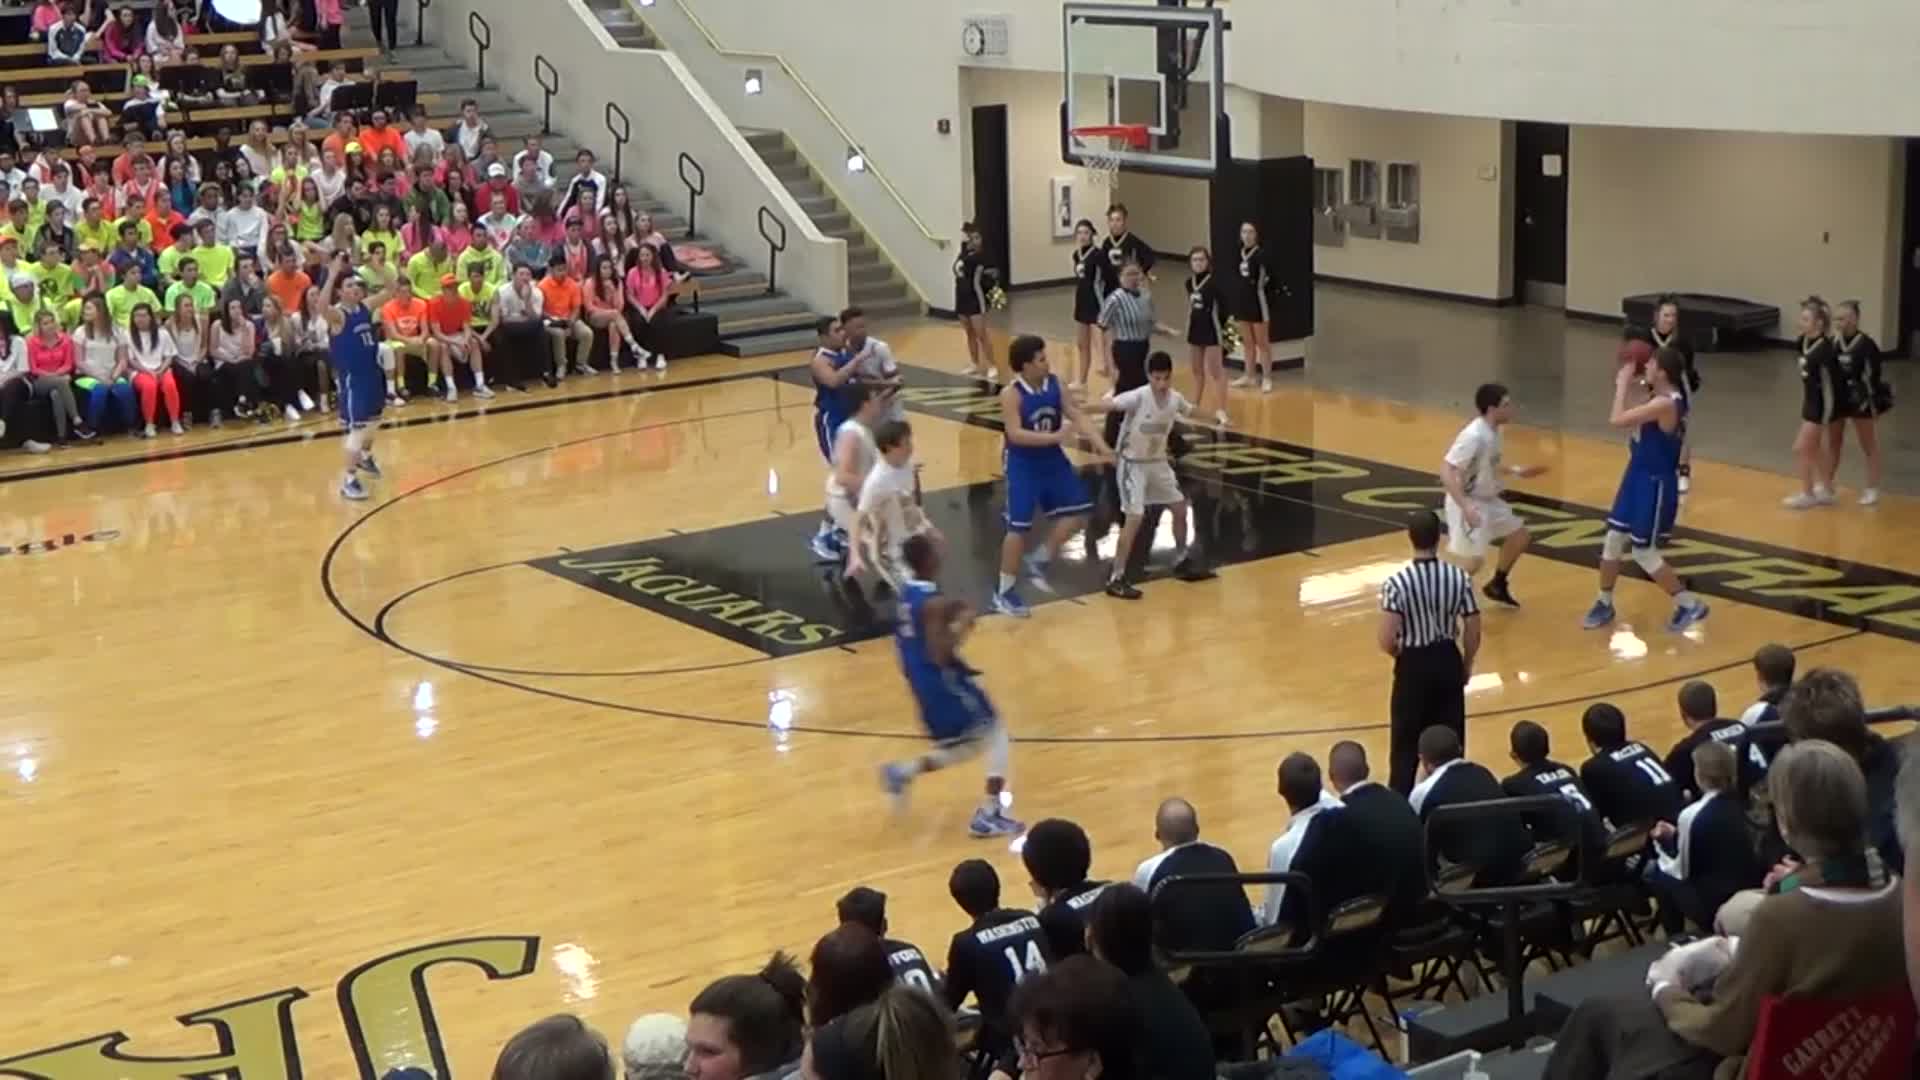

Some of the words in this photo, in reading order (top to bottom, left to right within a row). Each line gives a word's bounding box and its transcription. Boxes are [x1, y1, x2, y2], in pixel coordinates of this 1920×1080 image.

[557, 556, 846, 645] JAGUARS
[1635, 757, 1672, 785] 11
[1004, 939, 1048, 984] 14
